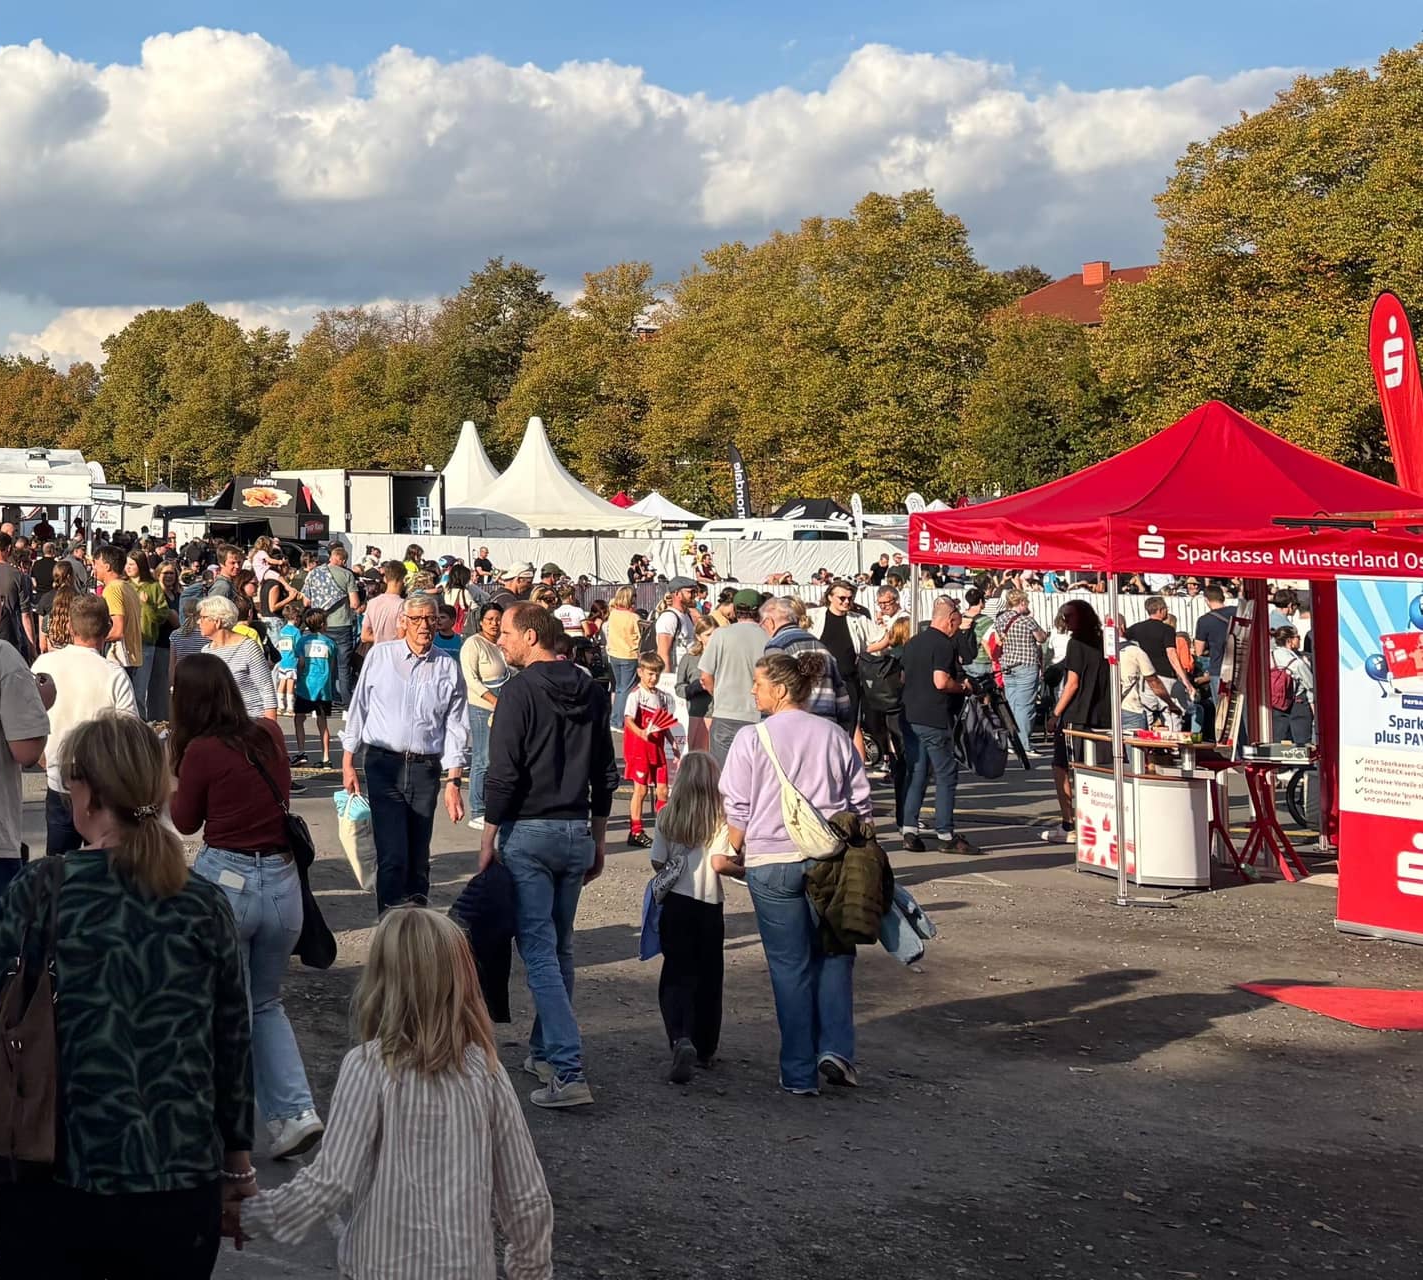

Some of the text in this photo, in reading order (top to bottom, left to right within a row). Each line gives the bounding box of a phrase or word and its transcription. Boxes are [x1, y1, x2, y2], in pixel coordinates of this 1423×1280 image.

[933, 538, 971, 555] Sparkasse
[971, 540, 1022, 557] Münsterland
[1023, 541, 1040, 557] Ost
[1177, 544, 1273, 565] Sparkasse
[1279, 548, 1399, 569] Münsterland
[1375, 730, 1401, 745] plus
